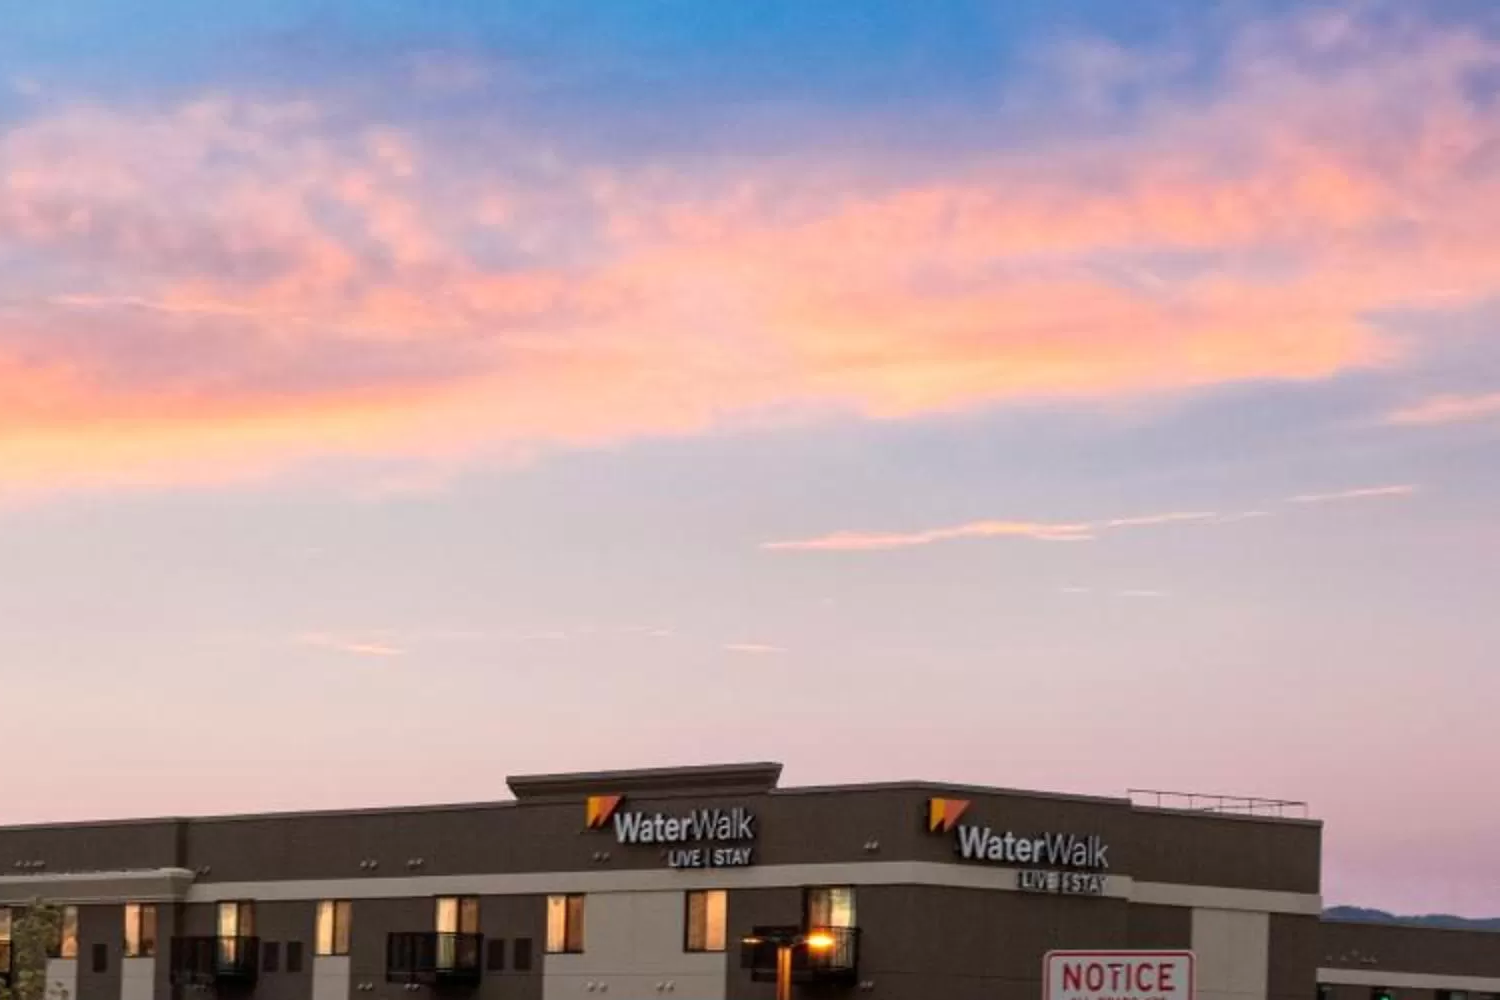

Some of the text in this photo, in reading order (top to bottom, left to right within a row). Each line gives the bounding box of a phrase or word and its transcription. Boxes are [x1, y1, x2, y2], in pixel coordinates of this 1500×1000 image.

[613, 808, 753, 844] WaterWalk
[668, 848, 752, 867] LIVE STAY
[958, 824, 1109, 868] WaterWalk
[1021, 871, 1109, 894] LIVE STAY
[1062, 962, 1176, 993] NOTICE
